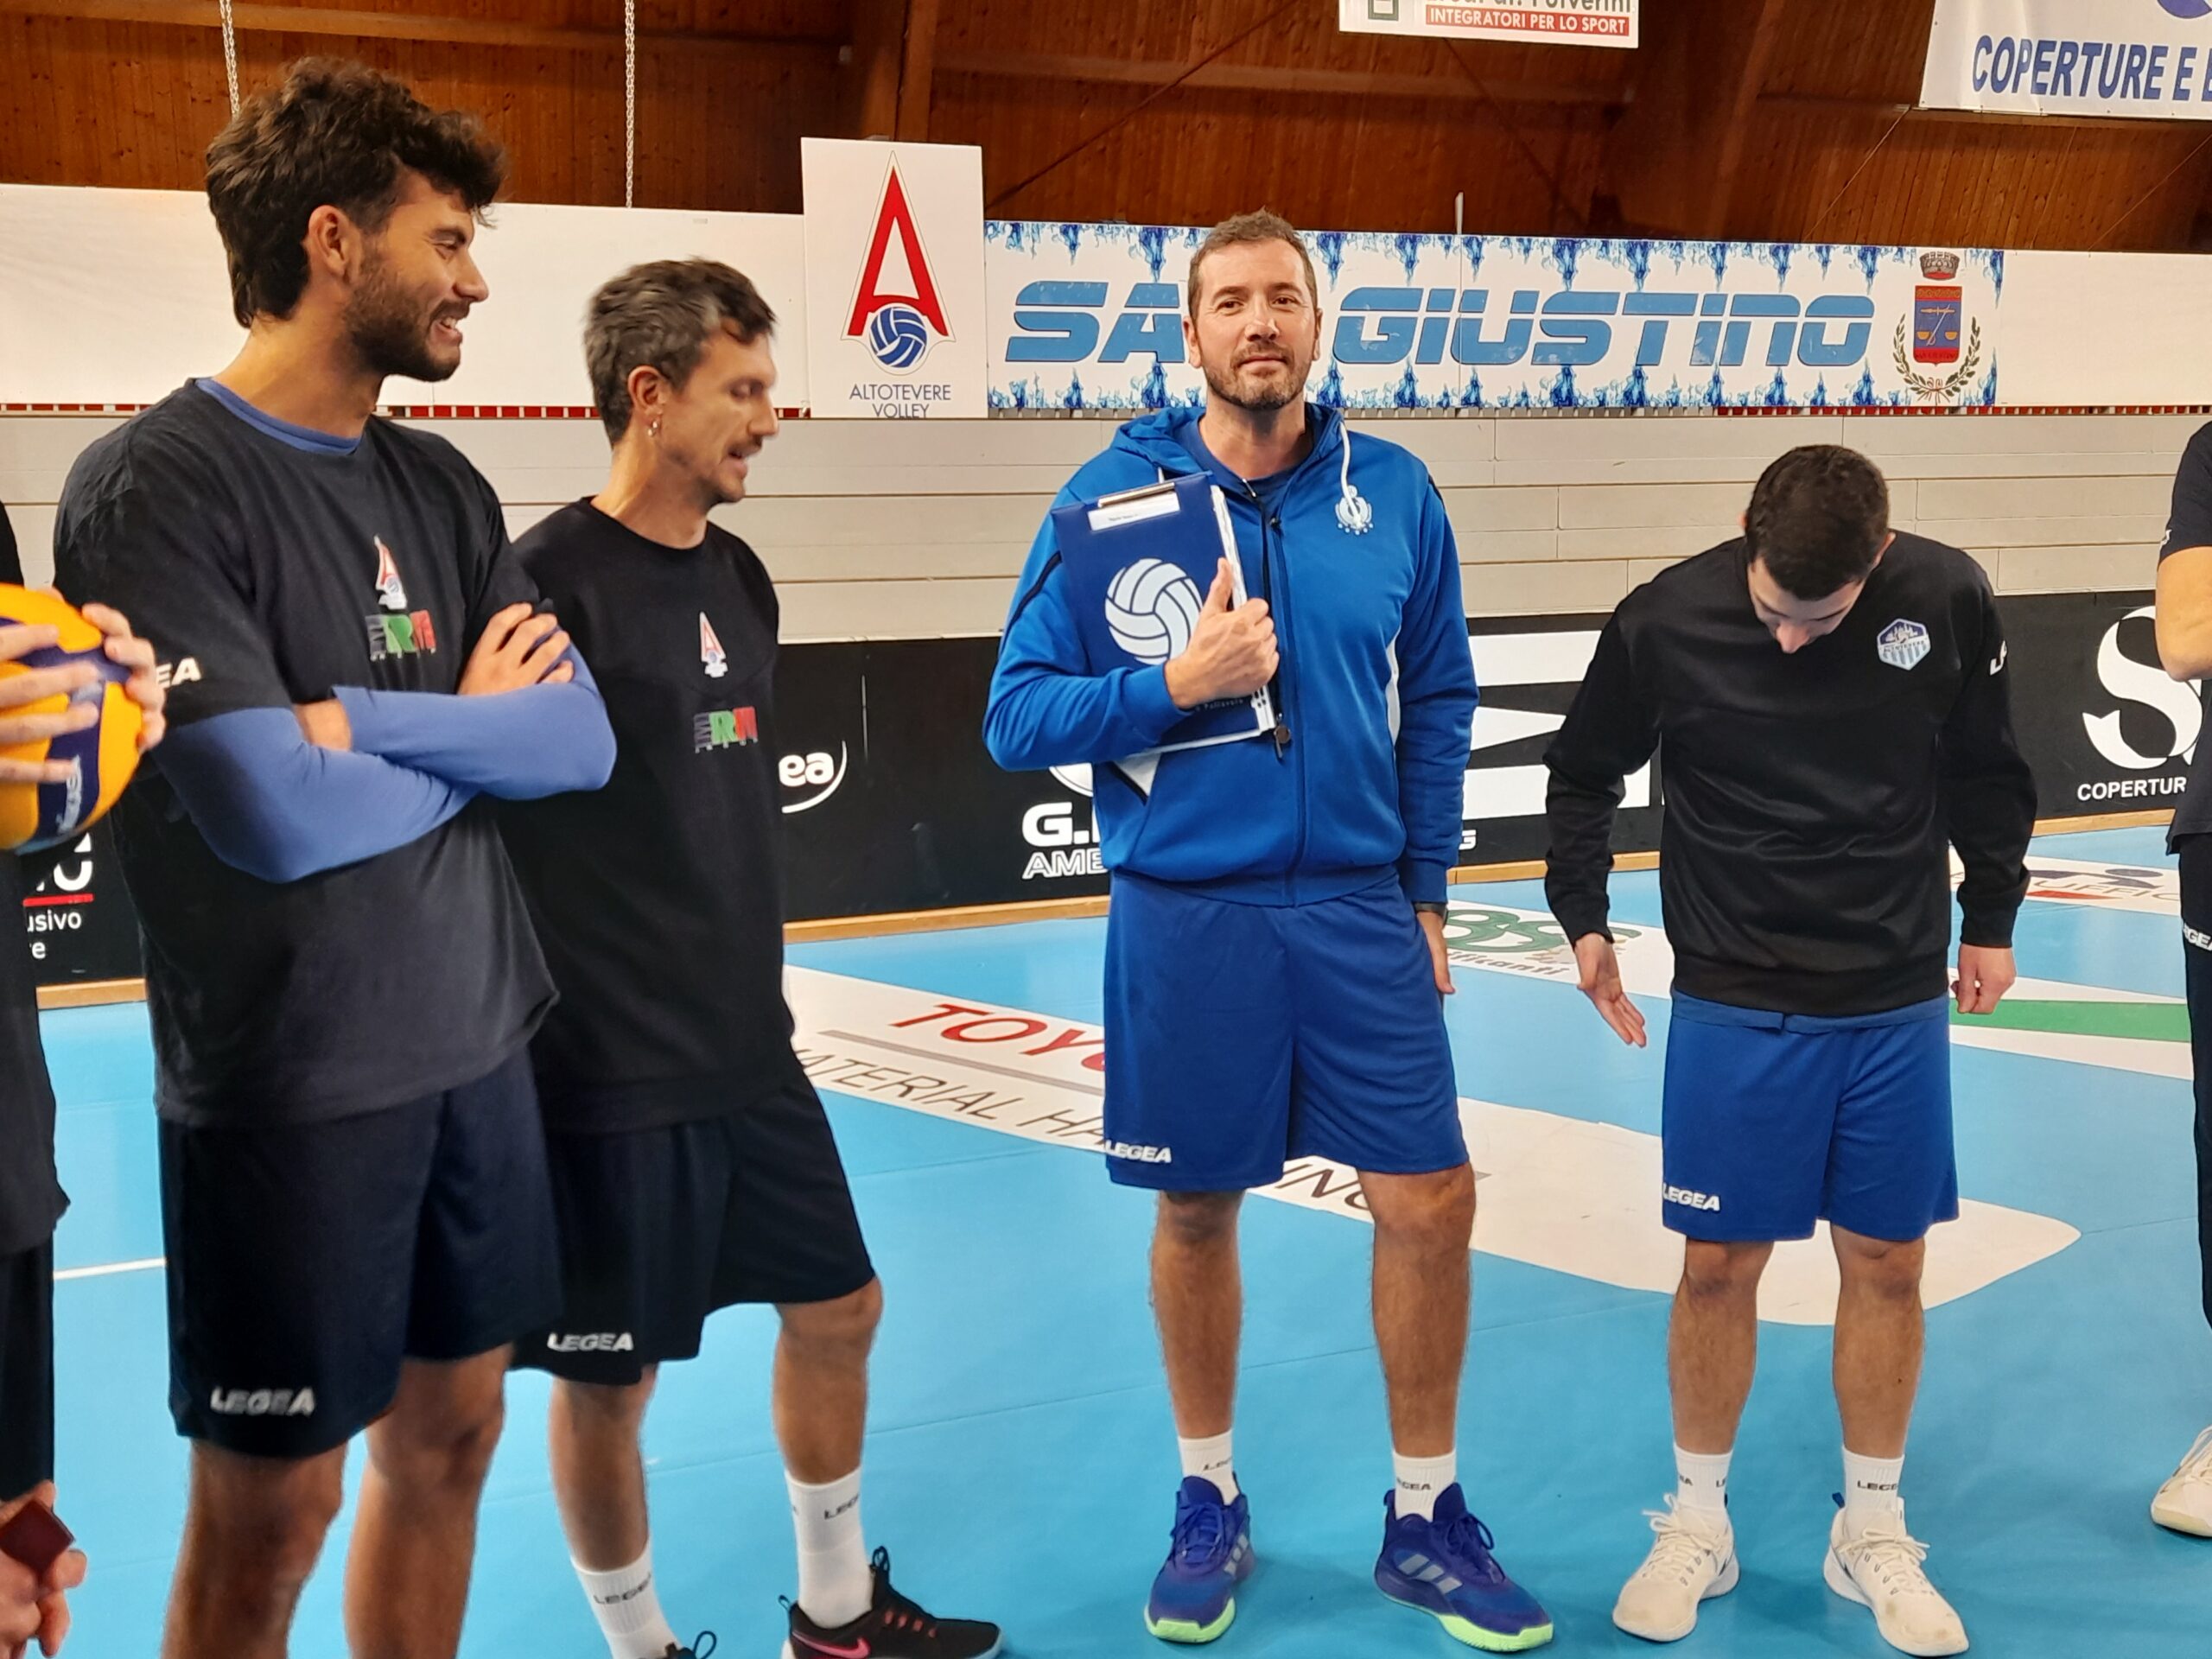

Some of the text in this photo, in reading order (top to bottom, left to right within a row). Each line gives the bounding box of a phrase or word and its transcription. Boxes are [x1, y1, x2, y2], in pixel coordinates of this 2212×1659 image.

[1430, 8, 1625, 33] INTEGRATORI PER LO SPORT
[1972, 35, 2169, 100] COPERTURE
[2172, 47, 2197, 101] E
[1005, 280, 1185, 363] SA
[849, 385, 951, 401] ALTOTEVERE
[872, 403, 930, 418] VOLLEY
[779, 752, 834, 787] ea
[2077, 777, 2187, 801] COPERTUR
[1022, 801, 1102, 847] G.
[1105, 1139, 1172, 1163] LEGEA
[1662, 1181, 1720, 1211] LEGEA
[547, 1332, 633, 1353] LEGEA
[210, 1386, 315, 1417] LEGEA
